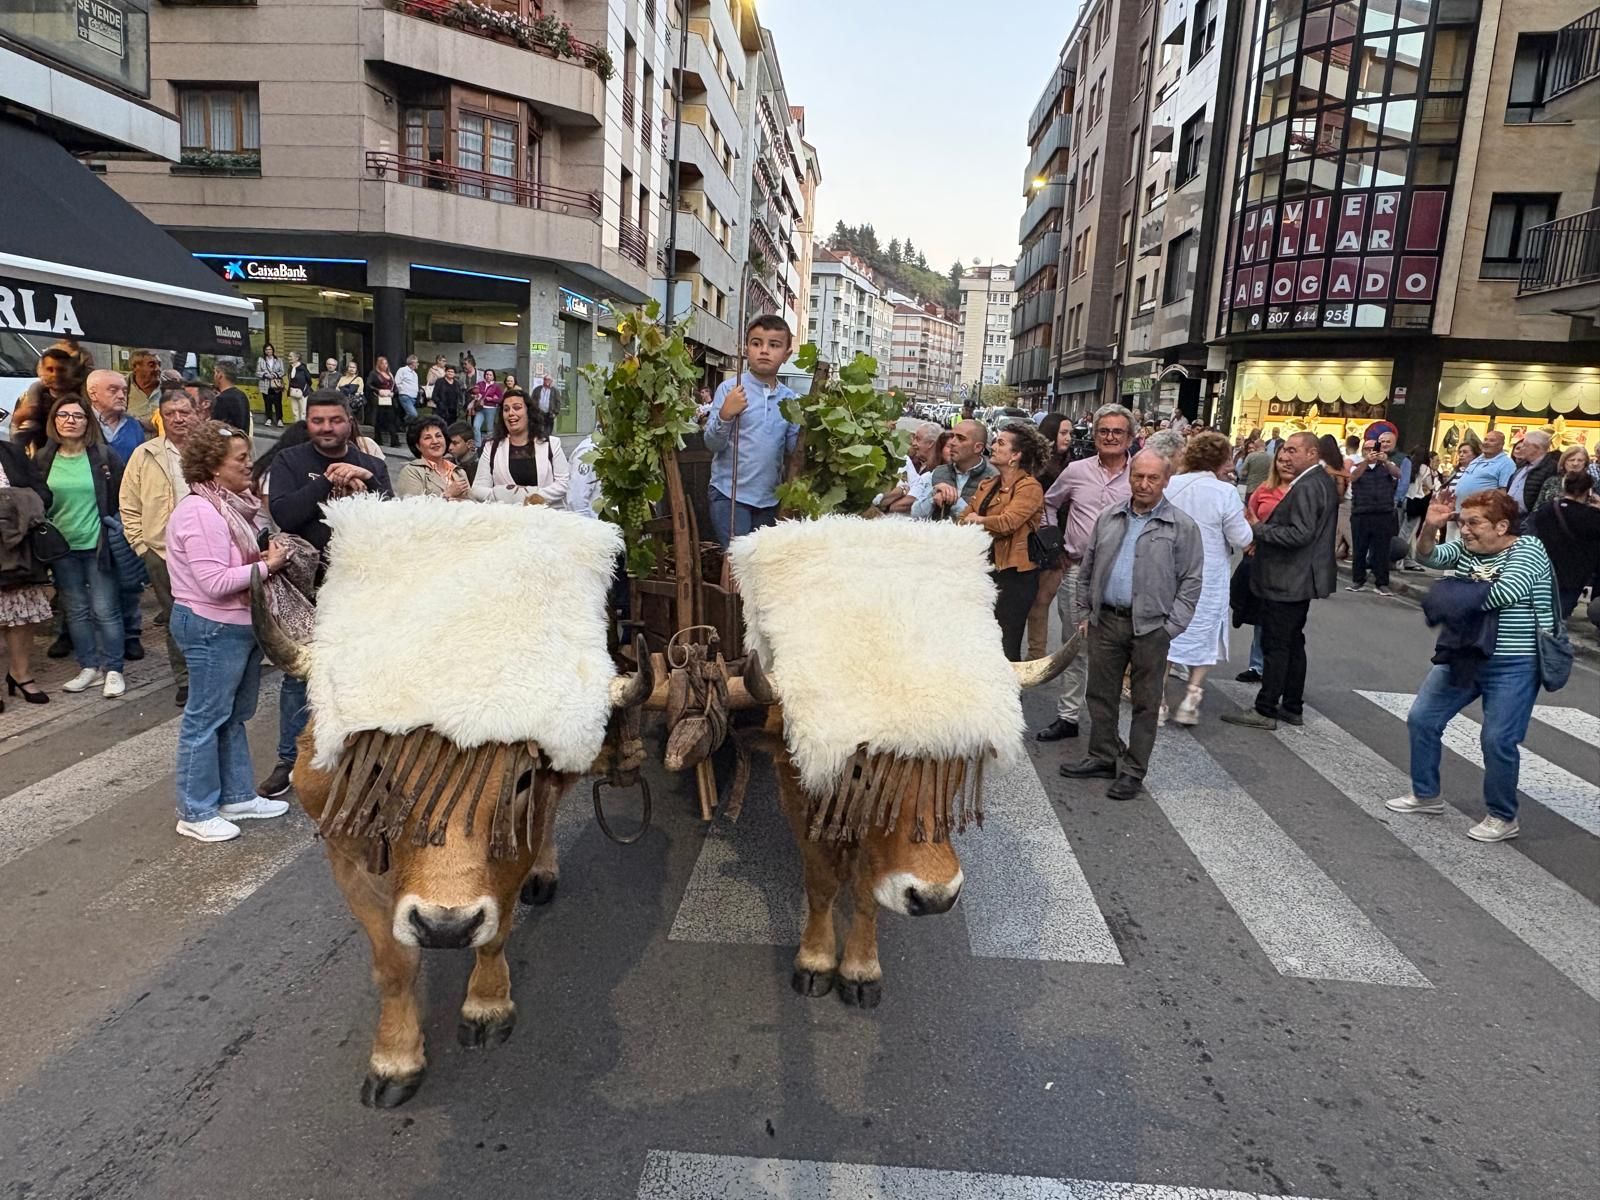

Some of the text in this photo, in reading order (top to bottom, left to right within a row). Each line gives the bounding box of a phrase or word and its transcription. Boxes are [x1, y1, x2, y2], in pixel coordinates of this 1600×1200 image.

[78, 0, 121, 29] SE VENDE
[1247, 195, 1395, 232] JAVIER
[1242, 229, 1391, 262] VILLAR
[247, 262, 307, 278] CaixaBank
[1236, 273, 1427, 301] ABOGADO
[1268, 312, 1289, 323] 607
[1295, 311, 1316, 322] 644
[215, 325, 242, 339] Mahou
